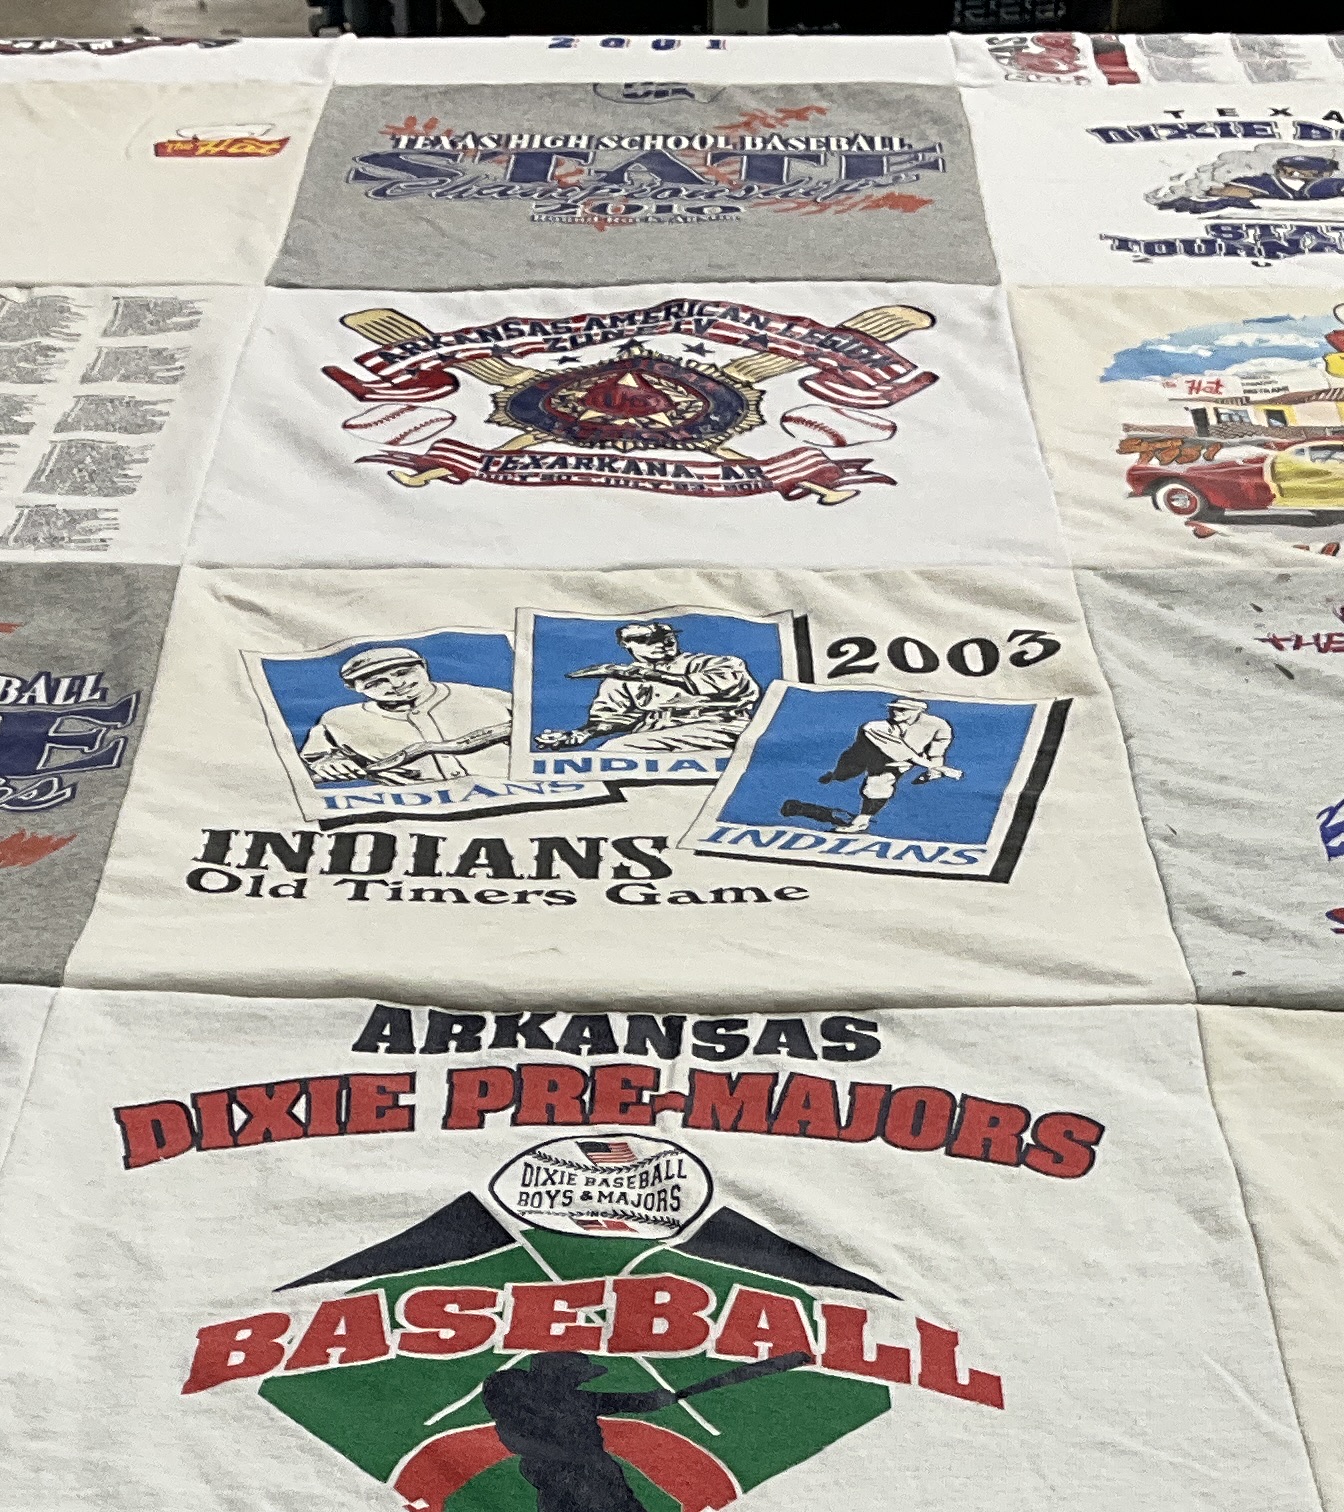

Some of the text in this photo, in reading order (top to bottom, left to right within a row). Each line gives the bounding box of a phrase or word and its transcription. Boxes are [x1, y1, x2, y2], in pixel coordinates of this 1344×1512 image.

[392, 134, 913, 152] TEXAS HIGH SCHOOL BASEBALL
[1087, 121, 1278, 146] DIXIE
[347, 142, 947, 185] STATE
[378, 318, 573, 366] ARKANSAS
[582, 300, 780, 337] AMERICAN
[827, 630, 1061, 679] 2003
[532, 755, 725, 775] INDIA
[321, 778, 589, 811] INDIANS
[192, 829, 672, 885] INDIANS
[700, 824, 990, 868] INDIANS
[185, 866, 812, 908] Old Timers Game
[350, 1003, 884, 1062] ARKANSAS
[117, 1062, 1106, 1182] DIXIE PRE-MAJORS
[521, 1159, 688, 1189] DIXIE BASEBALL
[517, 1184, 682, 1212] BOYS & MAJORS
[179, 1272, 1006, 1411] BASEBALL
